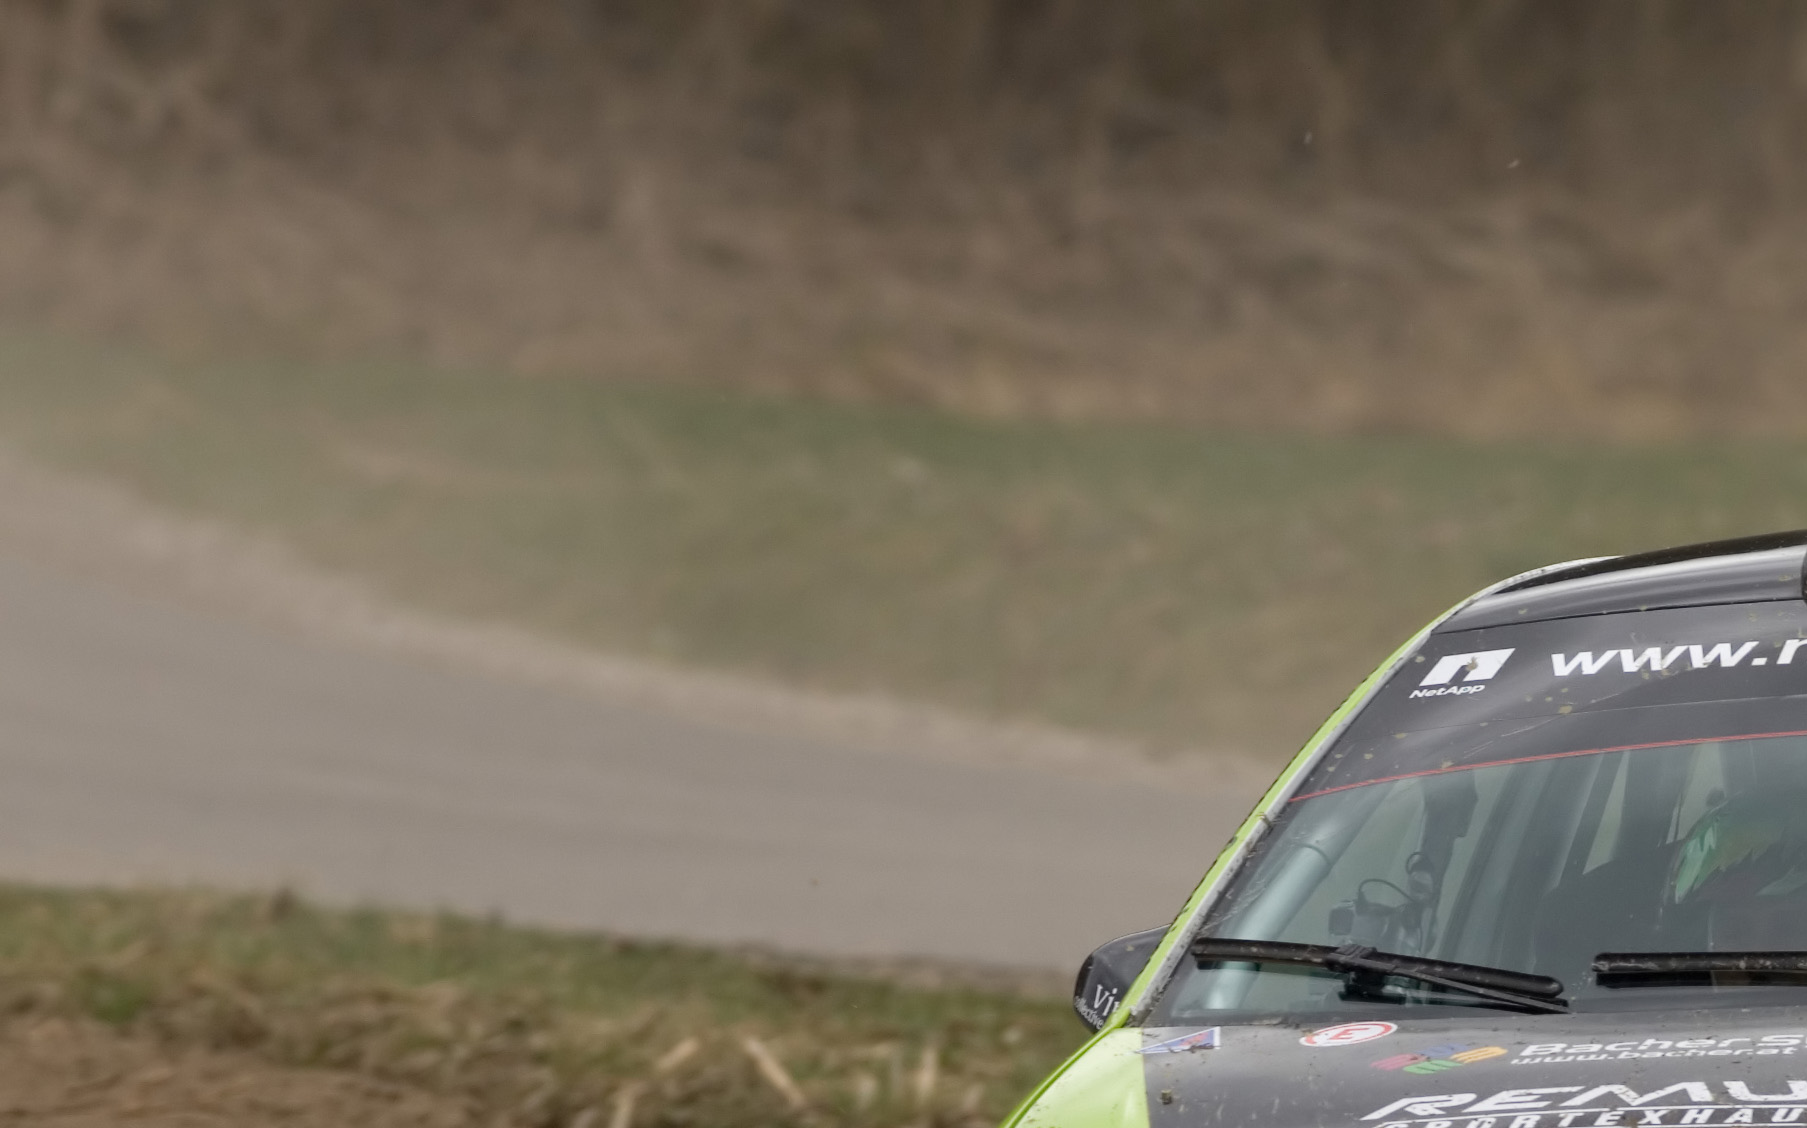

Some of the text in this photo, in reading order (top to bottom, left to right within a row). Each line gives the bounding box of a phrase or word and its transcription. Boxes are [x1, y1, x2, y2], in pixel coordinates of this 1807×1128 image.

[1409, 681, 1486, 699] NetApp
[1093, 983, 1121, 1017] vi
[1510, 1046, 1799, 1065] www.bacher.at
